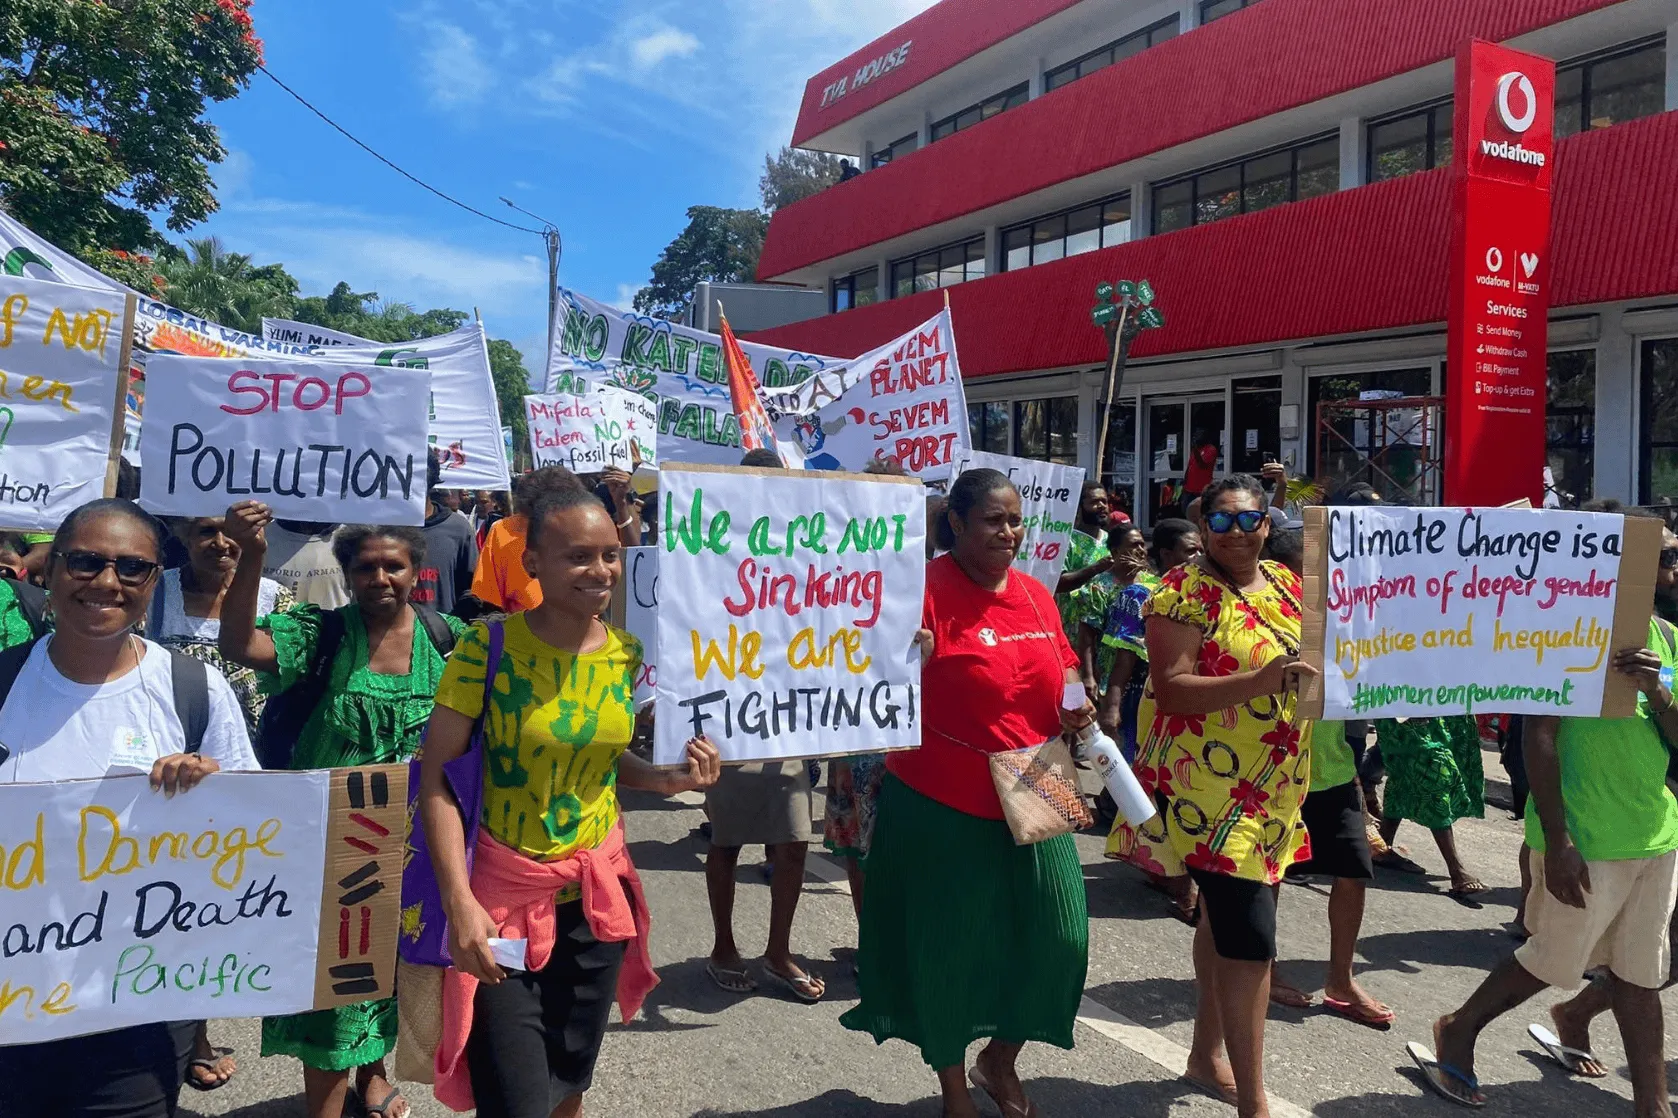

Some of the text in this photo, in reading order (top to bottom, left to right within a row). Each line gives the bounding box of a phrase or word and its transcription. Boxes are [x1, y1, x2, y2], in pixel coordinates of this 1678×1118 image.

[820, 40, 912, 108] TVL HOUSE
[1481, 139, 1545, 167] vodafone
[1475, 274, 1511, 289] vodafone
[42, 306, 119, 358] NOT
[138, 298, 210, 336] LOBAL
[1485, 324, 1522, 340] Send Money
[1486, 300, 1528, 319] Services
[561, 305, 610, 362] NO
[1485, 343, 1528, 358] Withdraw Cash
[869, 352, 949, 398] PLANET
[1482, 363, 1519, 376] Bill Payment
[1482, 382, 1503, 394] Top-up
[1509, 387, 1520, 397] get
[1520, 386, 1535, 397] Extra
[219, 370, 372, 416] STOP
[530, 396, 593, 426] Mifala
[534, 418, 622, 449] talem NO
[868, 398, 950, 440] SEVEM
[168, 422, 414, 500] POLLUTION
[569, 441, 606, 472] fossil
[610, 439, 628, 467] fuel
[1046, 486, 1070, 503] are
[664, 488, 907, 558] We are NOT
[1328, 509, 1447, 563] Climate
[1457, 511, 1562, 580] Change
[723, 557, 883, 629] Sinking
[1327, 564, 1618, 624] Symptom of deeper gender
[690, 624, 766, 682] We
[786, 626, 872, 675] are
[1335, 612, 1610, 680] Injustice and Inequality
[678, 680, 916, 741] FIGHTING!
[77, 805, 285, 892] Damage
[2, 873, 293, 958] and Death
[111, 943, 273, 1004] Pacific
